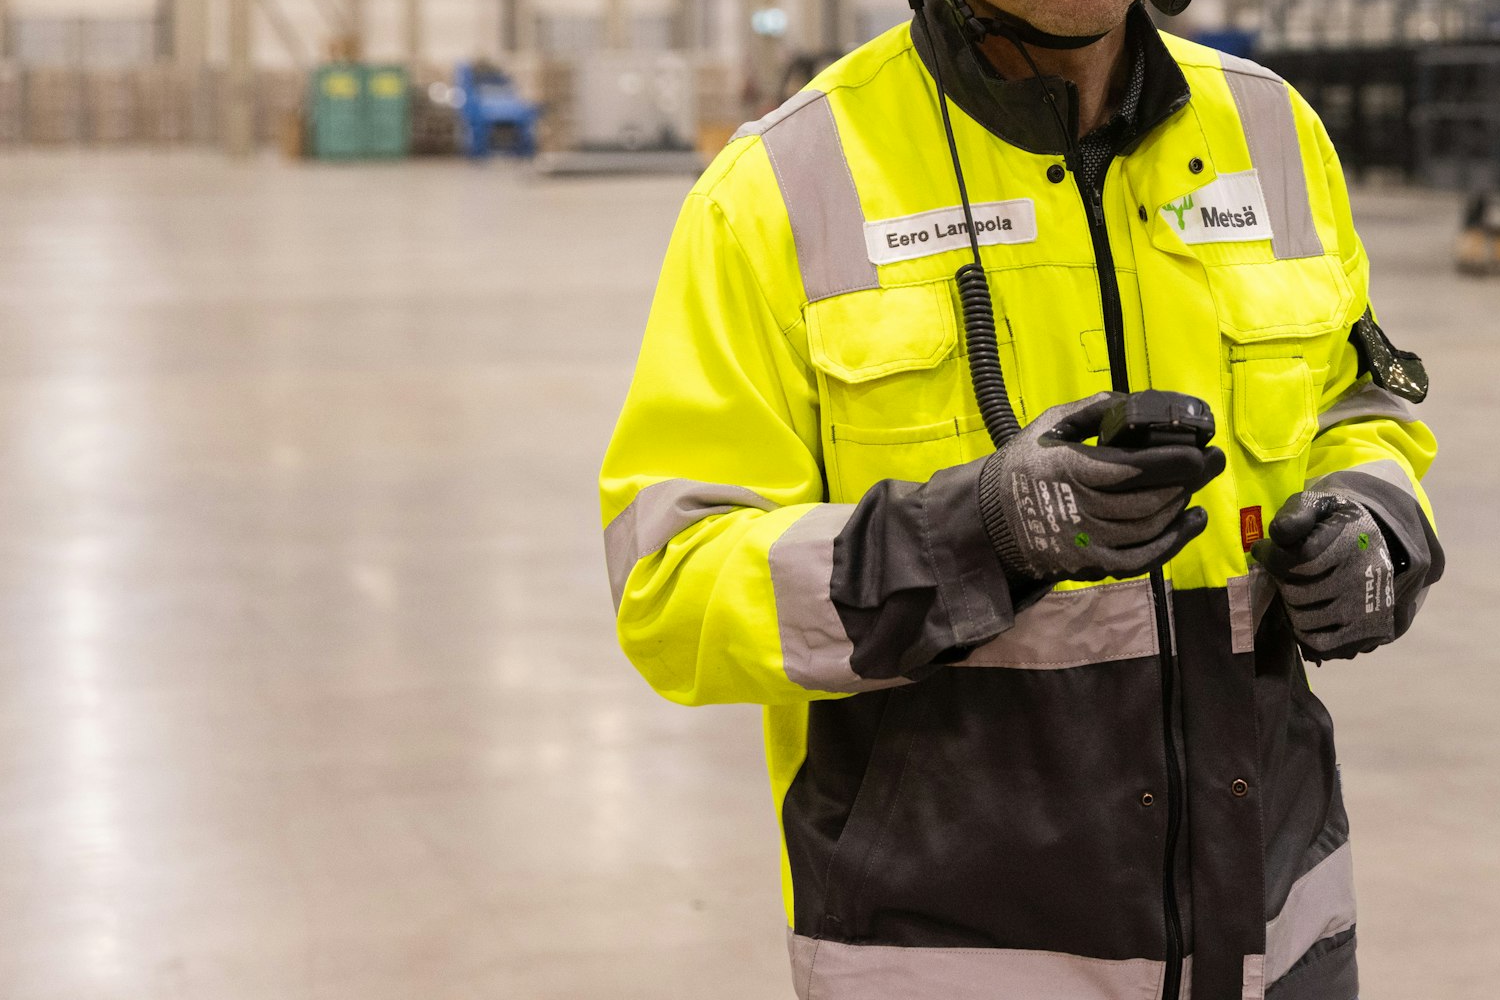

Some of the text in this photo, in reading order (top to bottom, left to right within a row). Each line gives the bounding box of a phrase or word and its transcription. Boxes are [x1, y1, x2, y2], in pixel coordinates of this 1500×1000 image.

[1201, 206, 1257, 227] Metsä
[886, 231, 929, 248] Eero
[1060, 483, 1081, 524] ETRA
[1365, 564, 1374, 613] ETRA
